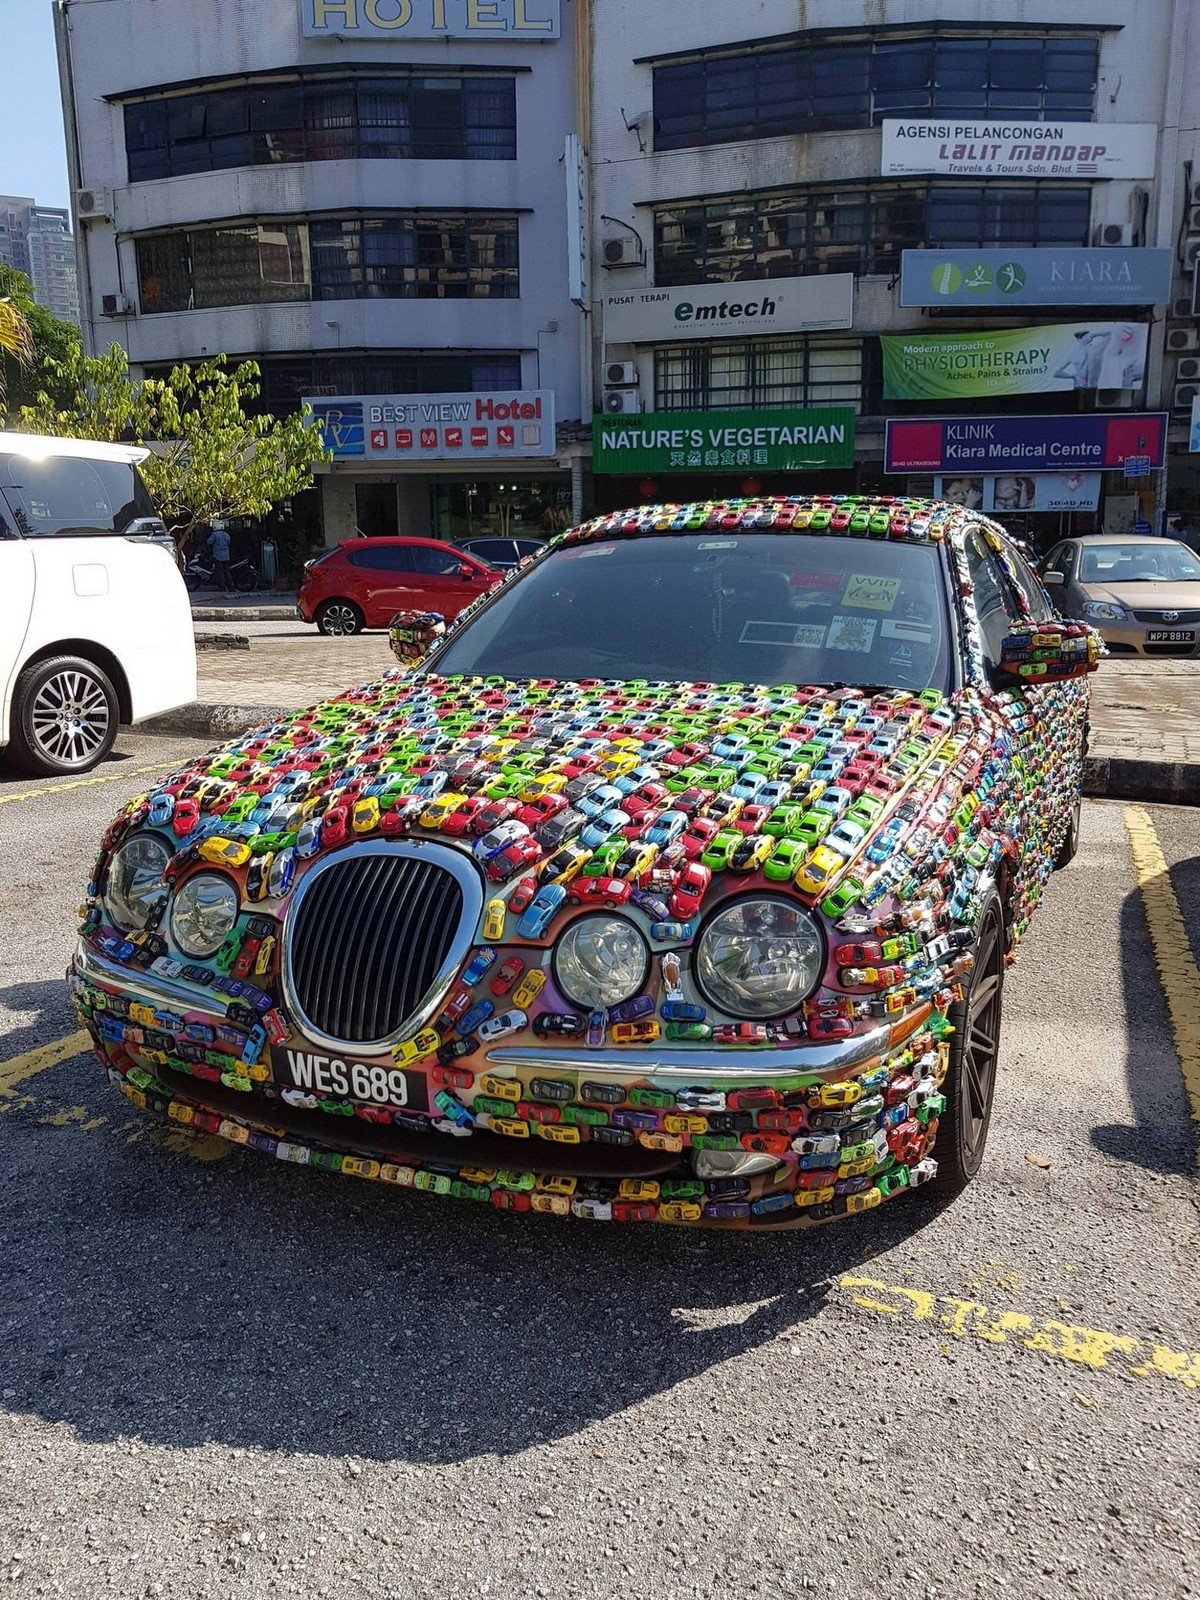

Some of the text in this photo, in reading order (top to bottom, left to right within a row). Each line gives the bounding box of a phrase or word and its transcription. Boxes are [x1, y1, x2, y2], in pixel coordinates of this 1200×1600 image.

[896, 125, 1064, 140] AGENSI PELANCONGAN
[948, 163, 1073, 174] Travels & Tours Sdn. Bhd.
[1050, 260, 1132, 281] KIARA
[608, 293, 670, 306] PUSAT TERAPI
[674, 297, 776, 322] emtech
[903, 340, 995, 354] Modern approach to
[903, 348, 1051, 371] PHYSIOTHERAPY
[947, 365, 1048, 380] Aches, Pains & Strains?
[370, 397, 542, 423] BEST VIEW Hotel
[709, 425, 845, 448] VEGETARIAN
[946, 424, 995, 440] KLINIK
[670, 449, 768, 466] 天然素食料理
[946, 442, 1102, 458] Kiara Medical Centre
[855, 577, 897, 588] VVIP
[1150, 632, 1168, 641] WPP
[286, 1050, 408, 1106] WES 689
